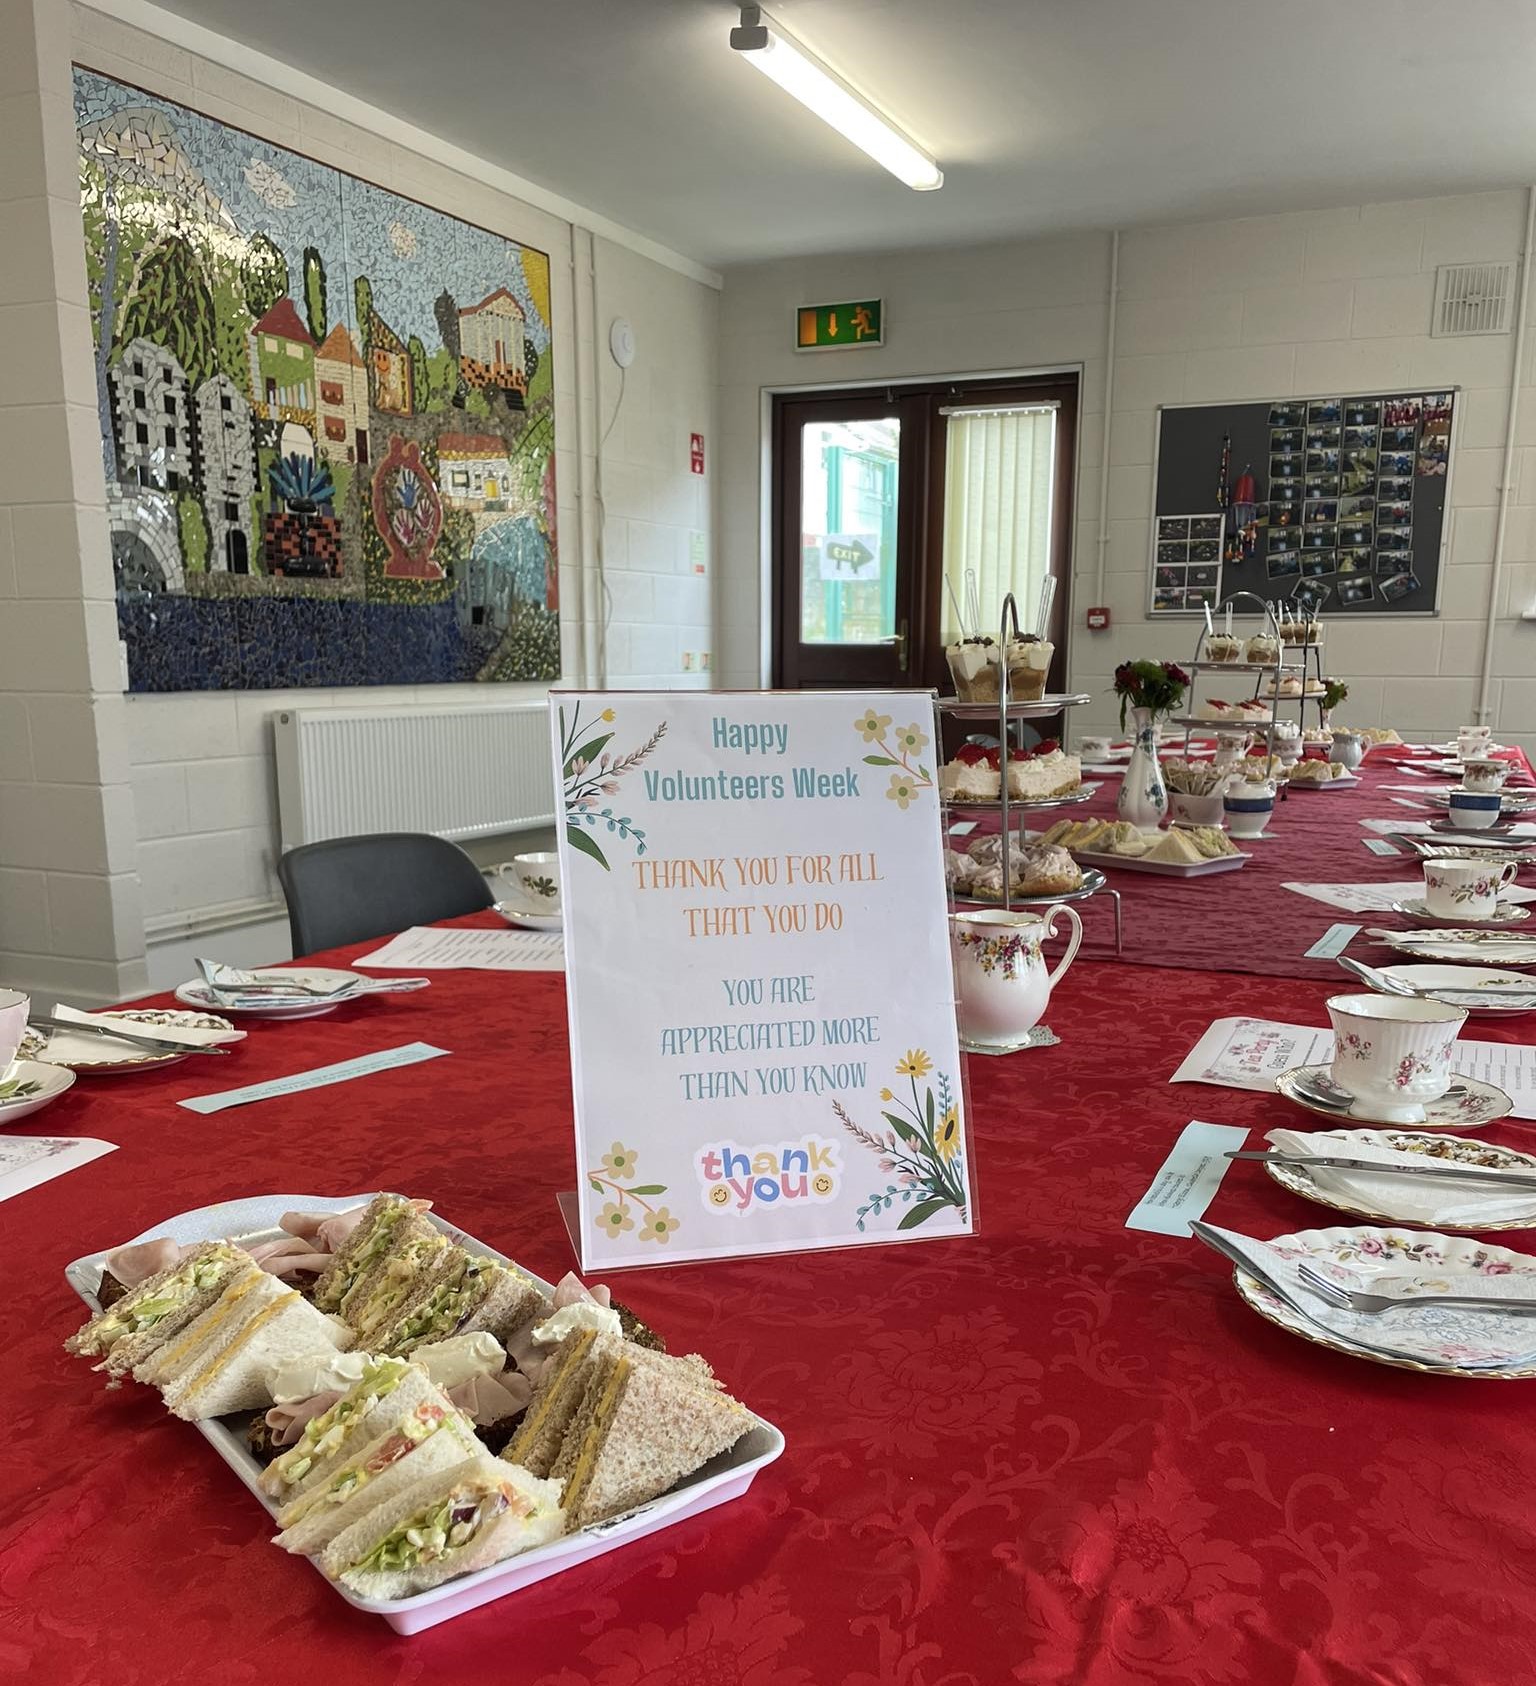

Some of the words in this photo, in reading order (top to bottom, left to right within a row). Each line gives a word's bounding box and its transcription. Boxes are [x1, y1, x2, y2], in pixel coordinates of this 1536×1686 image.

[832, 547, 860, 561] EXIT
[713, 717, 788, 754] Happy
[644, 769, 785, 801] Volunteers
[792, 767, 860, 798] Week
[632, 858, 728, 891] THANK
[732, 856, 778, 886] YOU
[785, 854, 834, 885] FOR
[839, 853, 884, 882] ALL
[683, 906, 755, 937] THAT
[763, 904, 808, 933] YOU
[814, 903, 843, 931] DO
[722, 978, 763, 1006] YOU
[770, 975, 815, 1004] ARE
[661, 1020, 815, 1056] APPRECIATED
[821, 1016, 880, 1046] MORE
[679, 1069, 749, 1100] THAN
[756, 1067, 796, 1096] YOU
[801, 1062, 867, 1096] KNOW
[702, 1141, 835, 1181] thank
[727, 1173, 808, 1209] you
